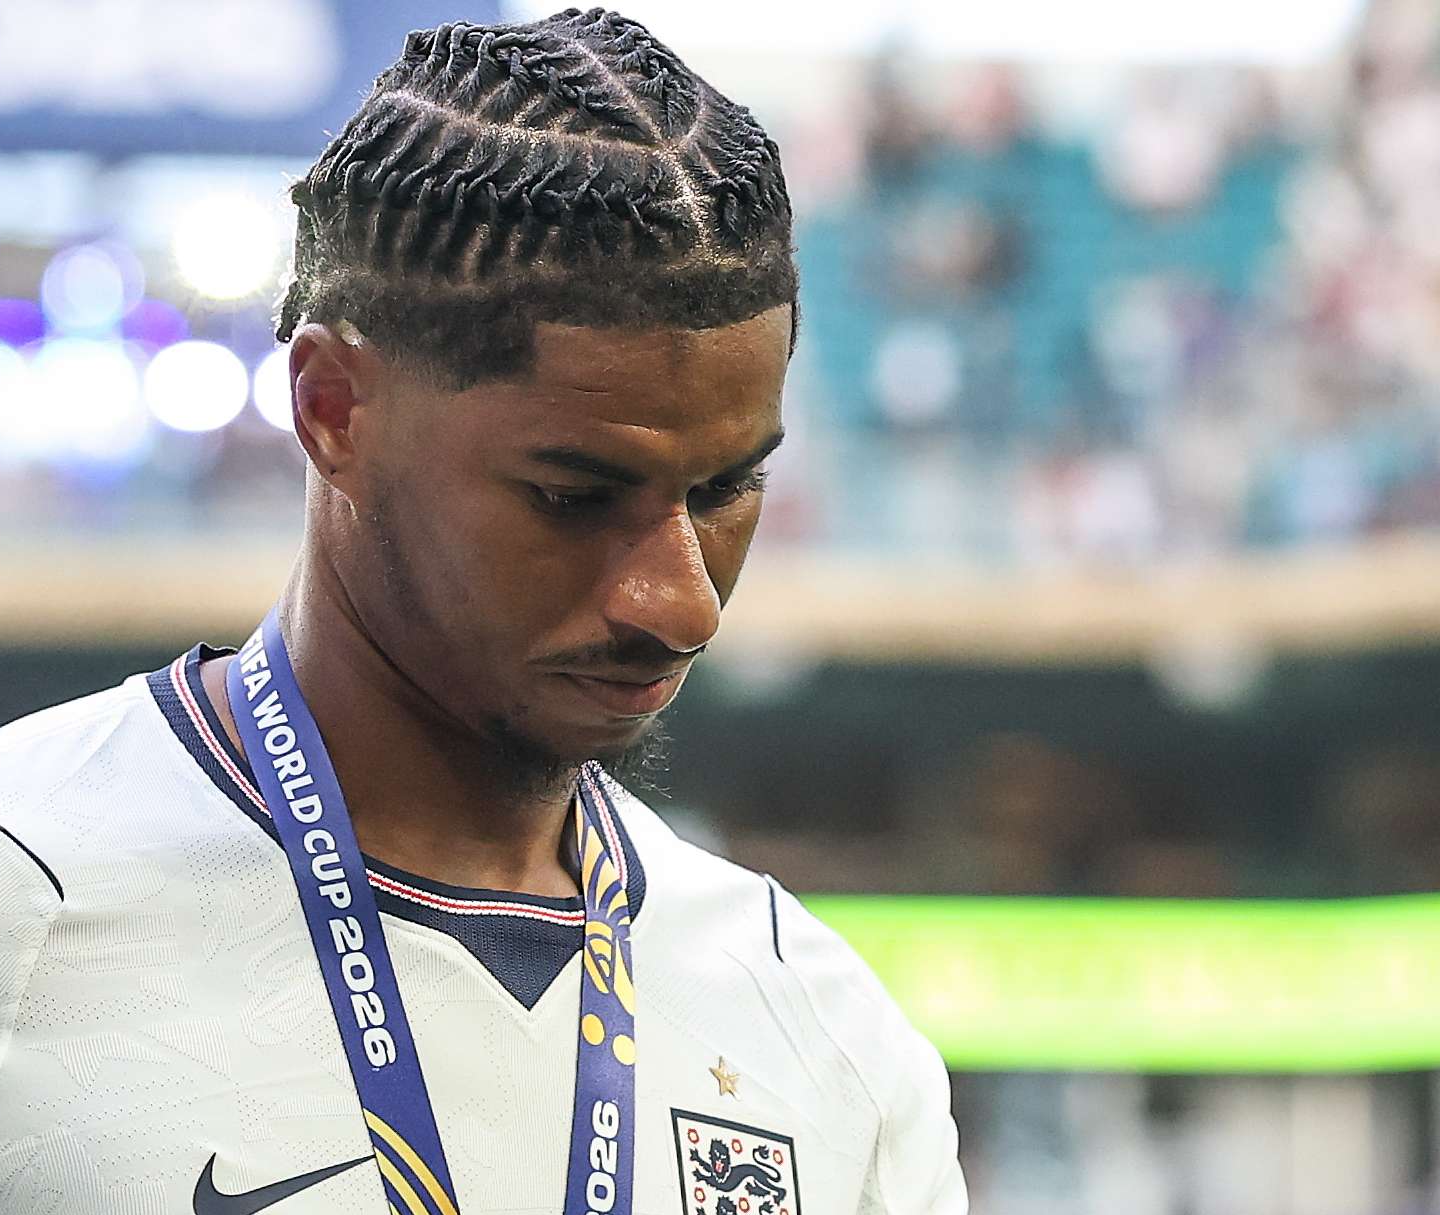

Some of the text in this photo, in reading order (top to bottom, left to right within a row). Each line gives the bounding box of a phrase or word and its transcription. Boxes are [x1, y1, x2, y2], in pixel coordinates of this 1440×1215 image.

[252, 690, 323, 824] WORLD
[303, 829, 353, 909] CUP
[329, 916, 397, 1067] 2026
